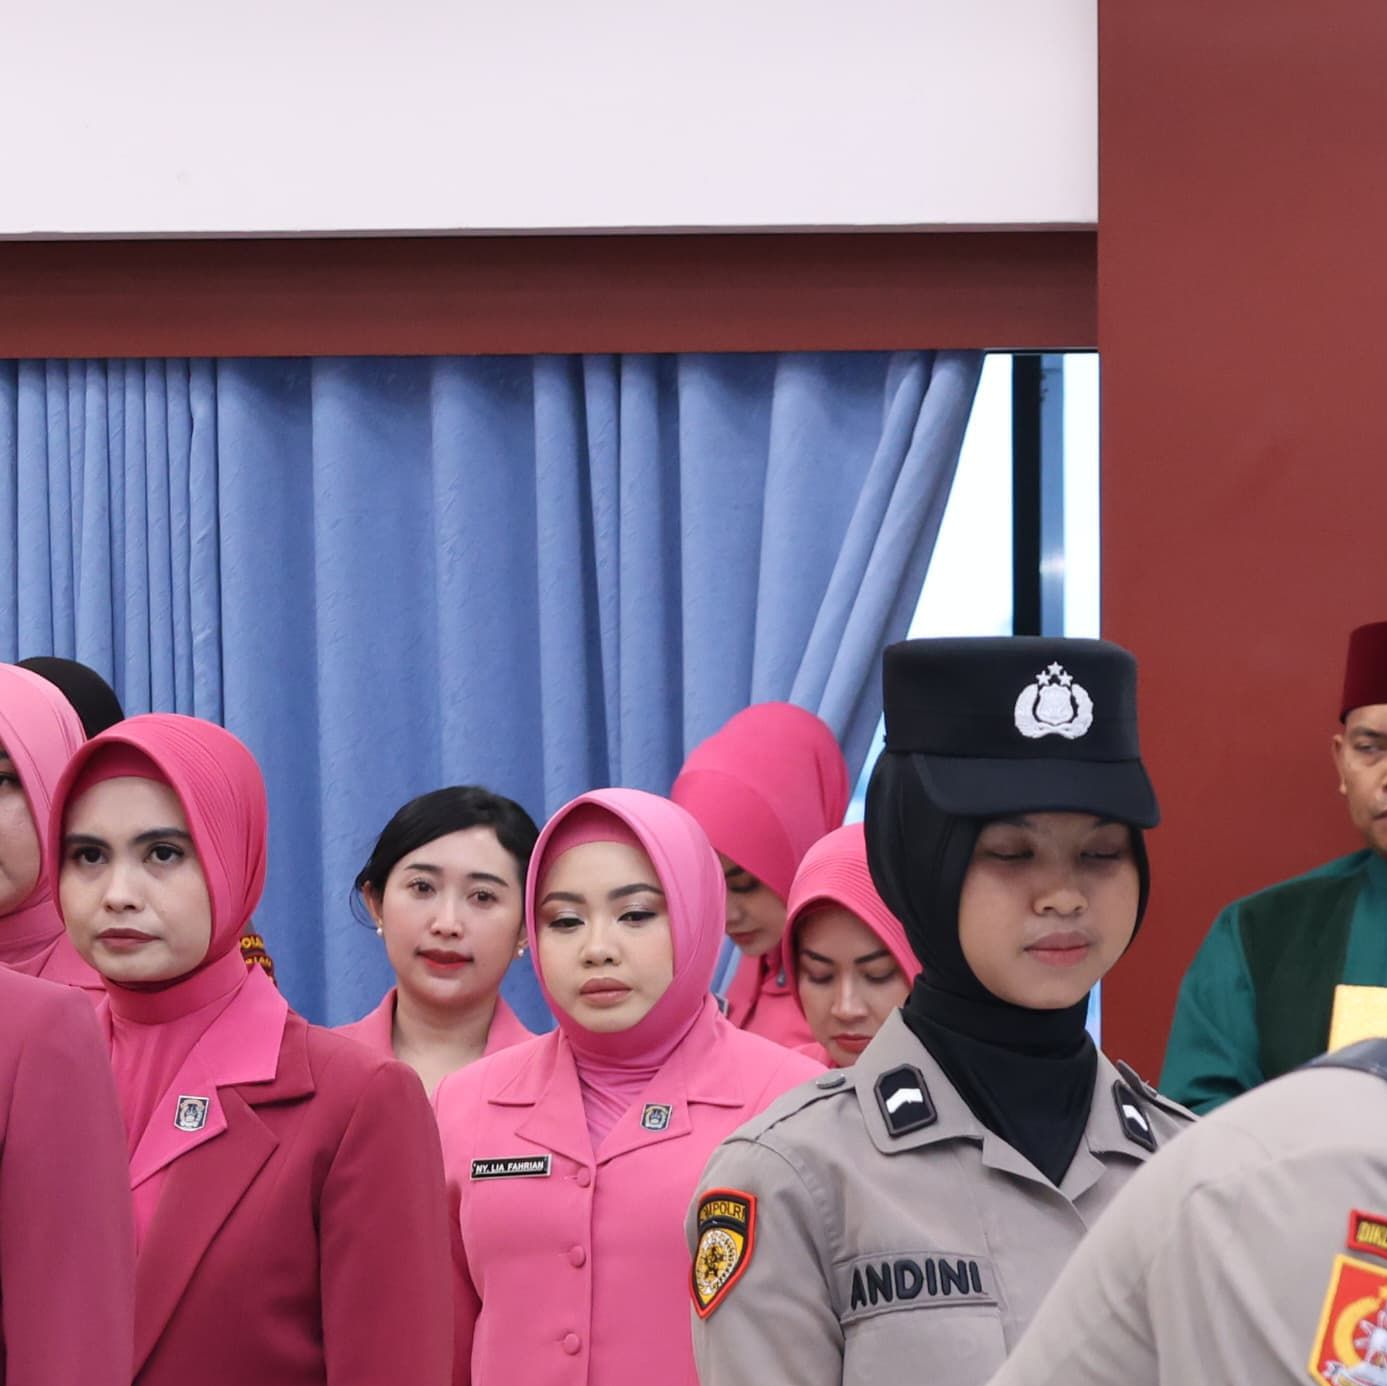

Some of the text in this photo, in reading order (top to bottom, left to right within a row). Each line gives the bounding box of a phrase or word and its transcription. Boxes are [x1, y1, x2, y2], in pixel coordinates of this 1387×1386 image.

[490, 1162, 505, 1174] LIA
[507, 1160, 544, 1172] FAHRIAN
[850, 1258, 983, 1311] ANDINI
